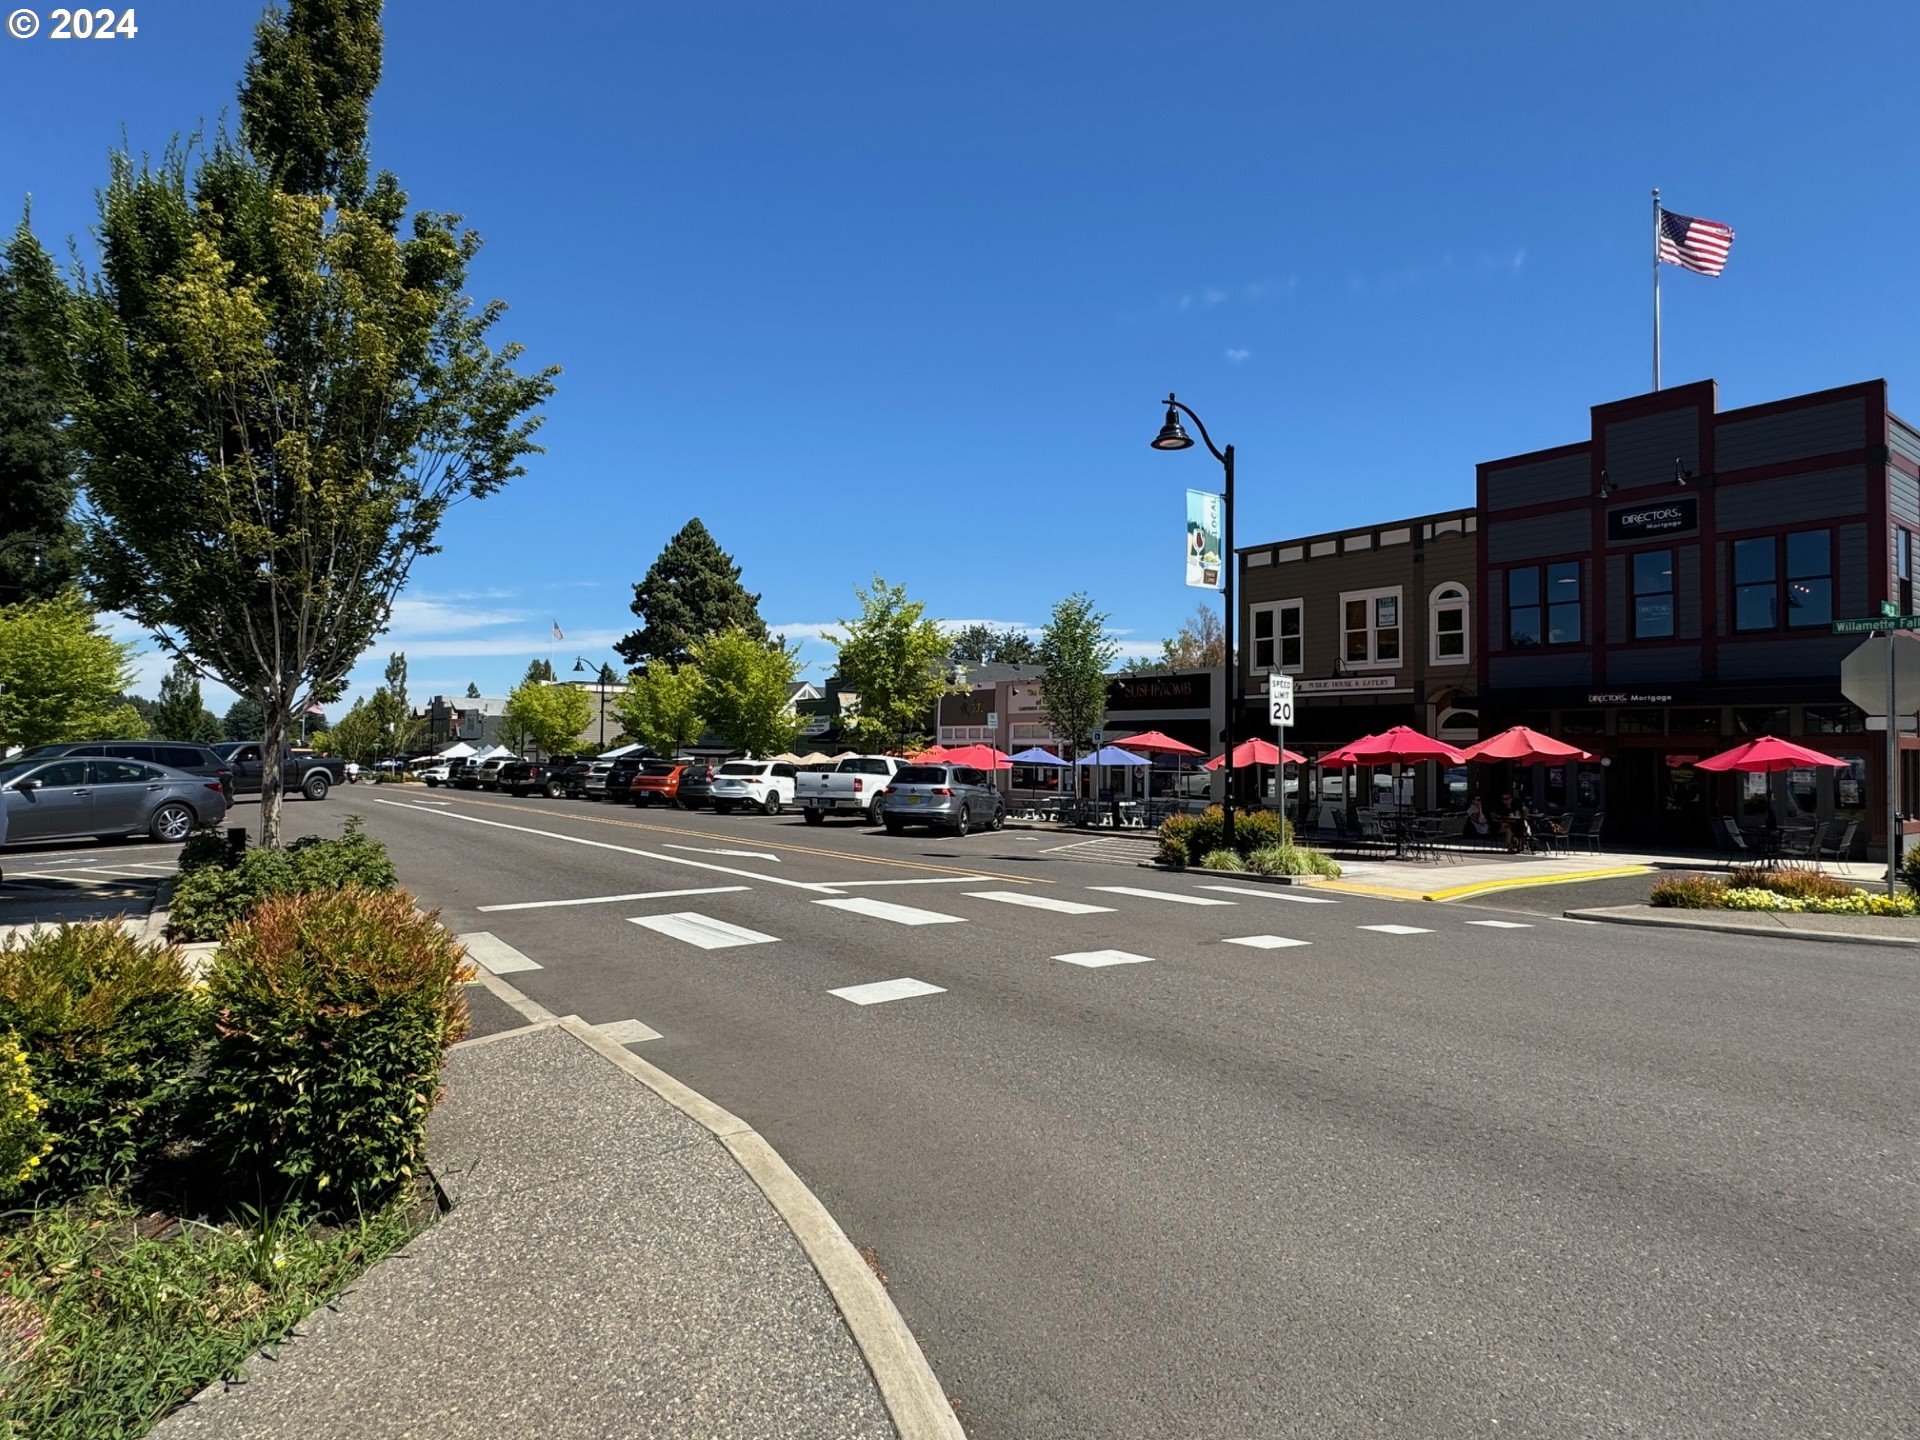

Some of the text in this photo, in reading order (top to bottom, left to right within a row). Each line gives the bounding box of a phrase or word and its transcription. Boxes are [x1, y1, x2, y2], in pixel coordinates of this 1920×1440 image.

[1646, 521, 1682, 529] Mortgage
[1836, 621, 1895, 632] Willamette
[1272, 680, 1291, 689] SPEED
[1274, 691, 1290, 699] LIMIT
[1630, 694, 1672, 703] Mortgage
[1273, 702, 1291, 721] 20
